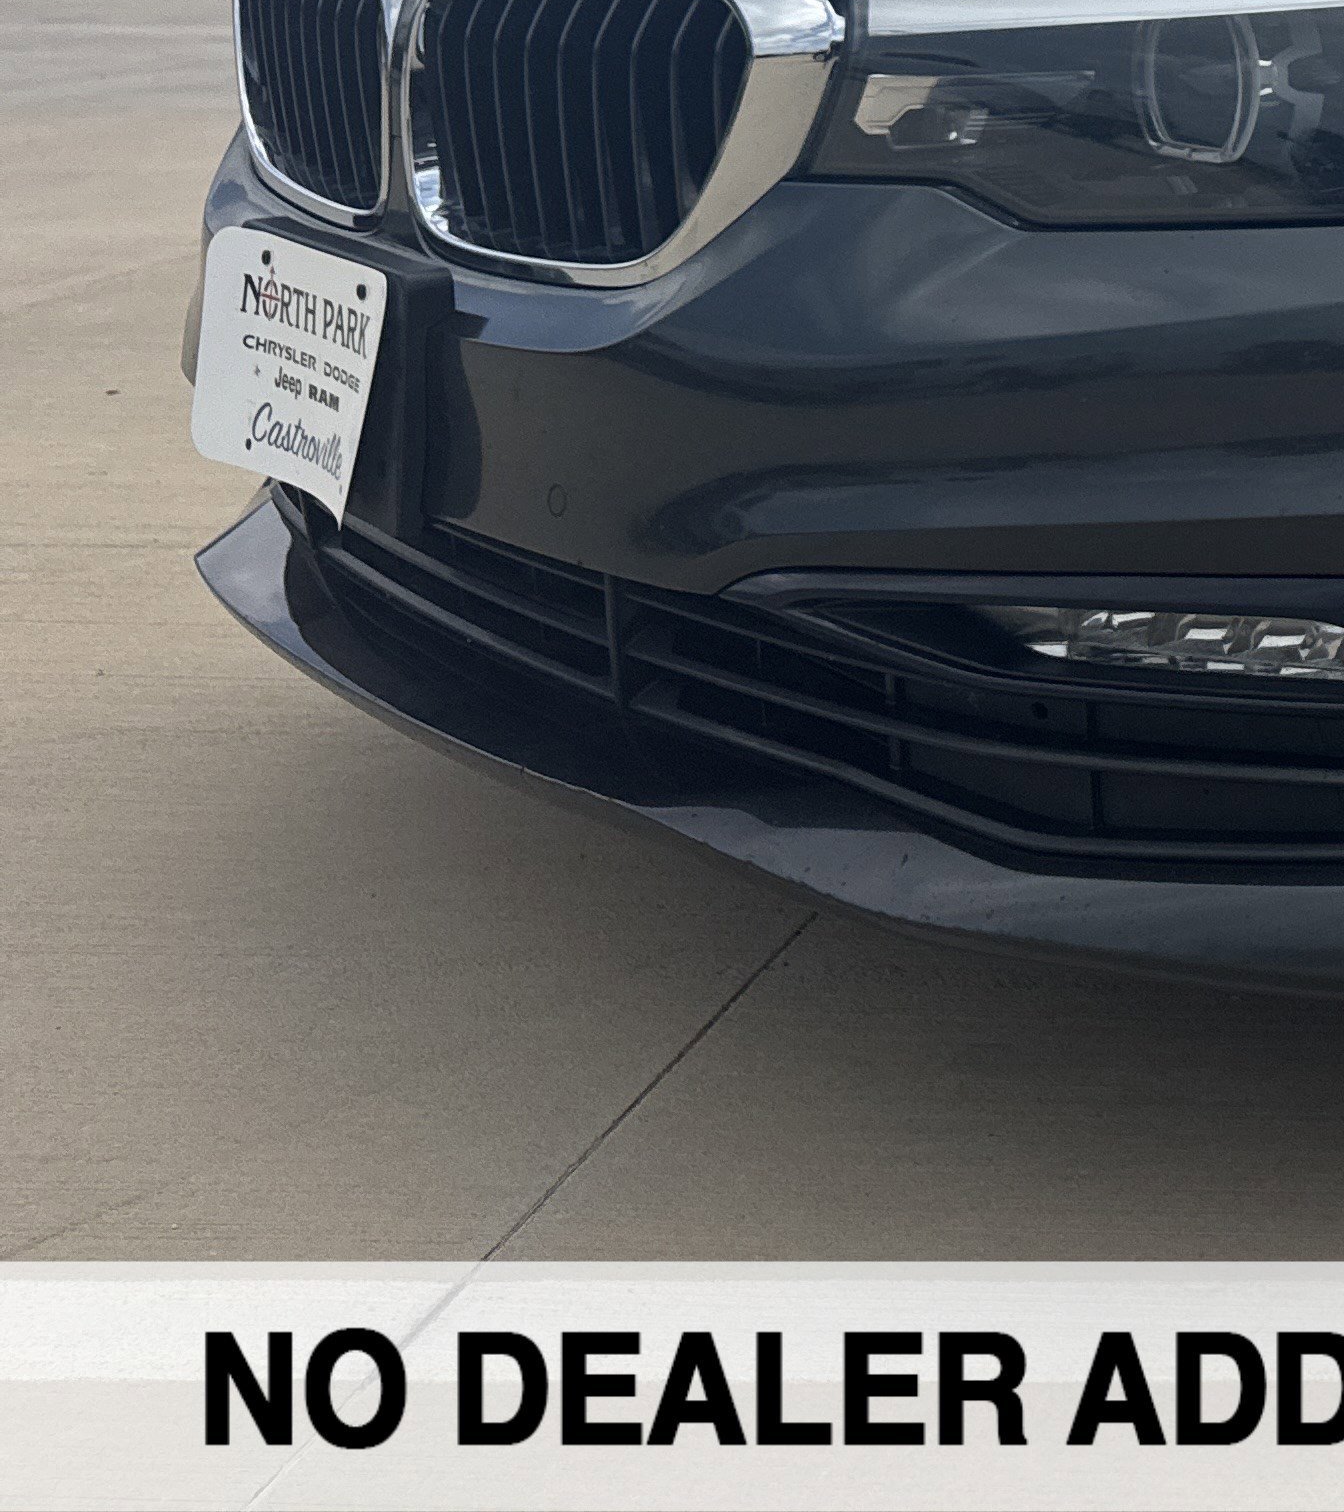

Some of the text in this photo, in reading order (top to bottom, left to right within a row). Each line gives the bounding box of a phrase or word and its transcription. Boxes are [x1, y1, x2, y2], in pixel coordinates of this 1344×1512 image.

[240, 272, 370, 359] NORTH PARK
[242, 334, 361, 393] CHRYSLER DODGE
[274, 366, 340, 412] Jeep RAM
[251, 401, 343, 480] Castroville
